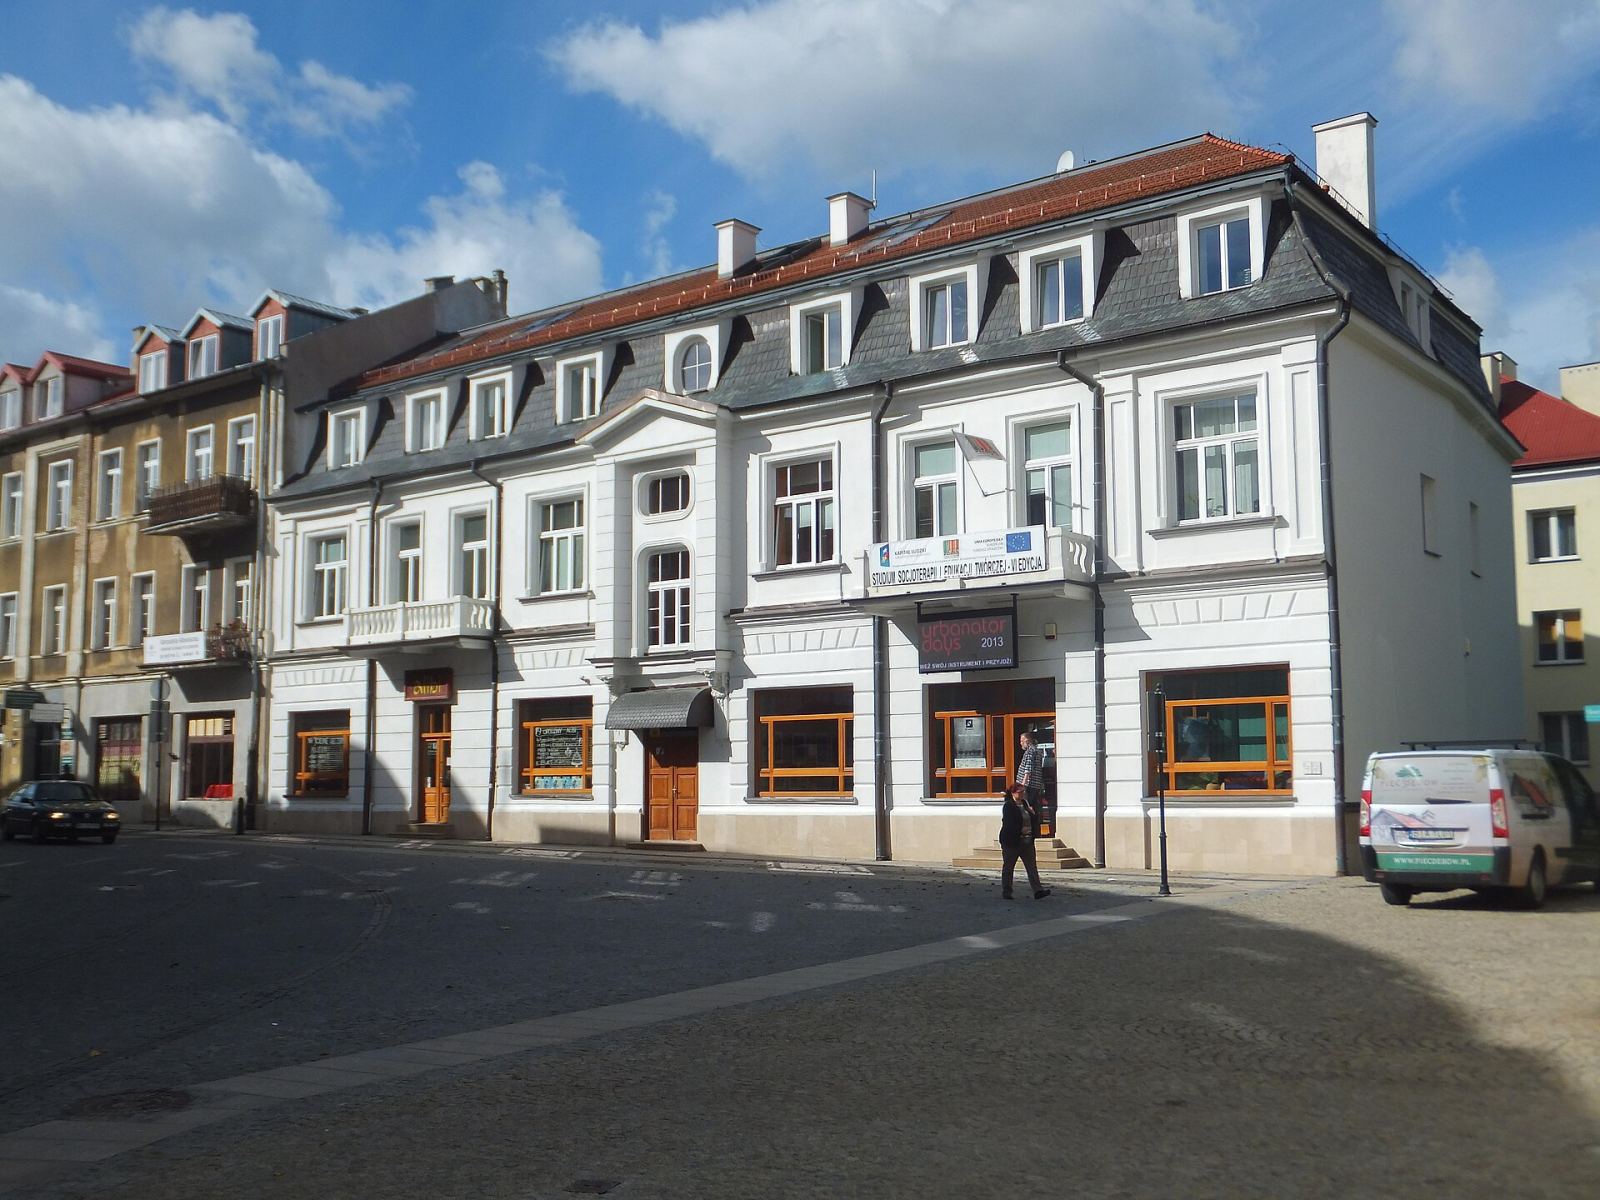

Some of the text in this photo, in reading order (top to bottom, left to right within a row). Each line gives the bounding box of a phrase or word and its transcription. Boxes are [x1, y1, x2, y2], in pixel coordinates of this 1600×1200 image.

[872, 571, 896, 586] STUDIUM
[897, 566, 938, 583] SOCJOTERAPII
[943, 562, 973, 578] EDUKACJI
[975, 558, 1007, 576] TWÓRCZEJ
[1018, 556, 1043, 572] EDYCJA
[921, 636, 961, 656] days
[981, 636, 1004, 648] 2013
